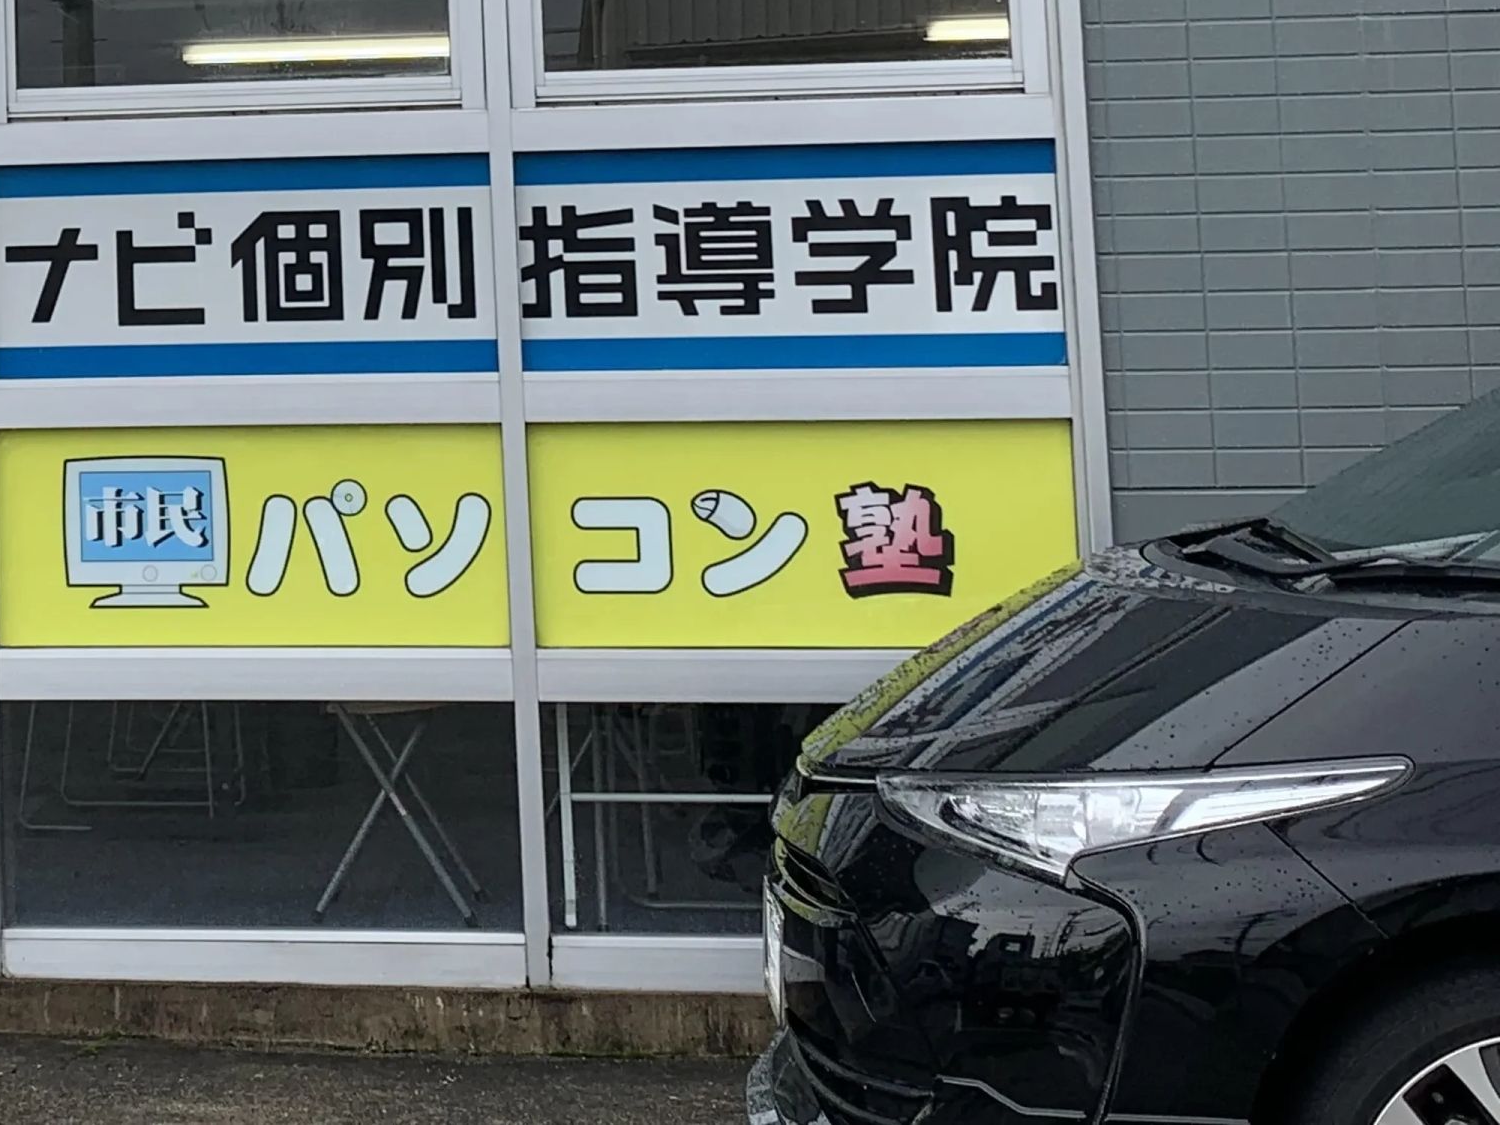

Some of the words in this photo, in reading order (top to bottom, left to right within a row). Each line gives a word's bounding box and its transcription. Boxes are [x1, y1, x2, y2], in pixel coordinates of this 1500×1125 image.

[5, 195, 1058, 326] ナビ個別指導学院
[84, 485, 209, 549] 市民
